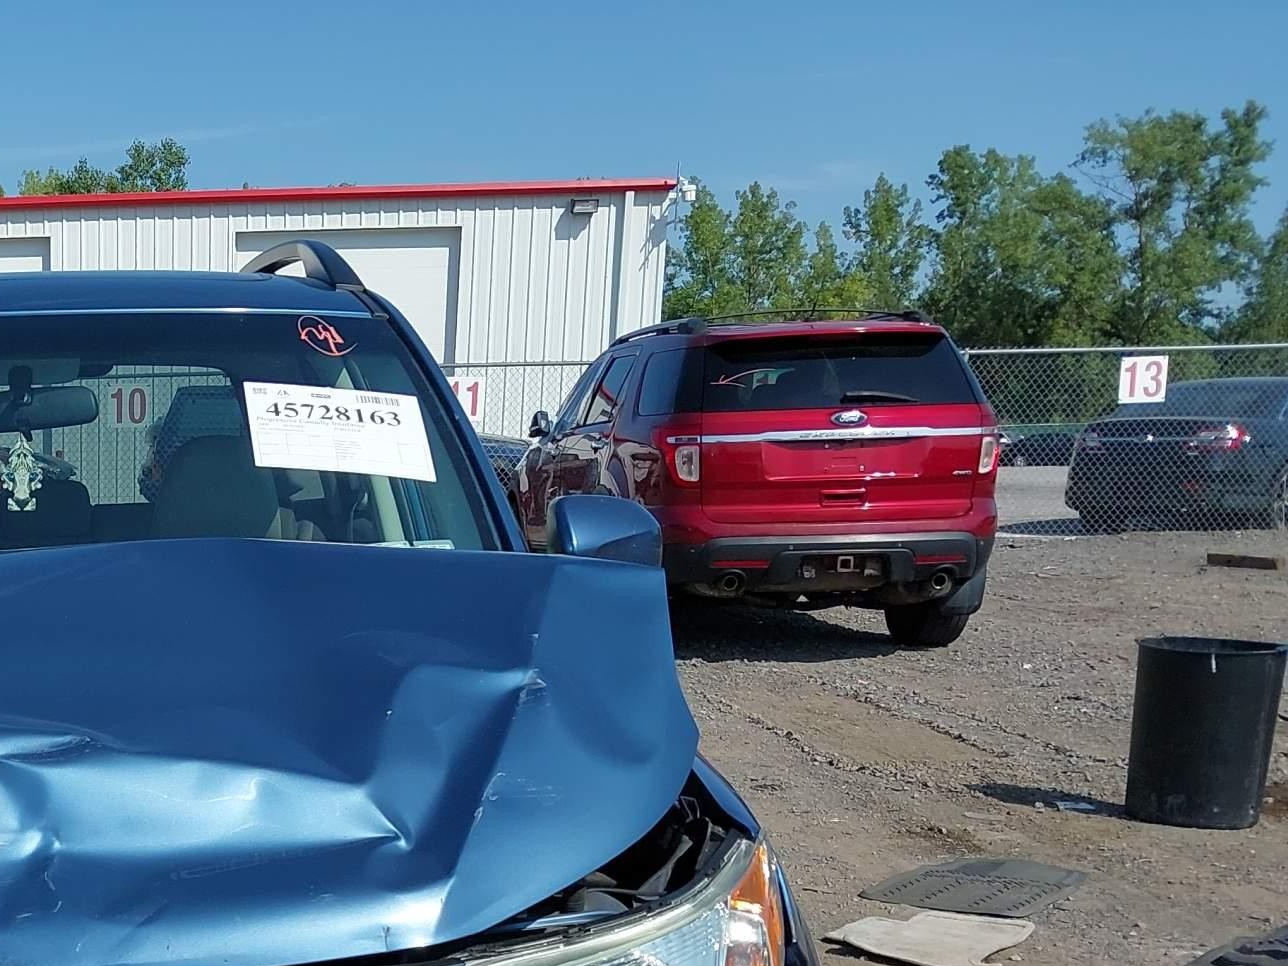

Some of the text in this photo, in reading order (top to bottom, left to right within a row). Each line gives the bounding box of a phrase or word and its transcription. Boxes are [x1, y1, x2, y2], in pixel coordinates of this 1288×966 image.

[1124, 360, 1163, 398] 13
[110, 387, 147, 424] 10
[265, 401, 402, 427] 45728163
[838, 410, 861, 422] Ford
